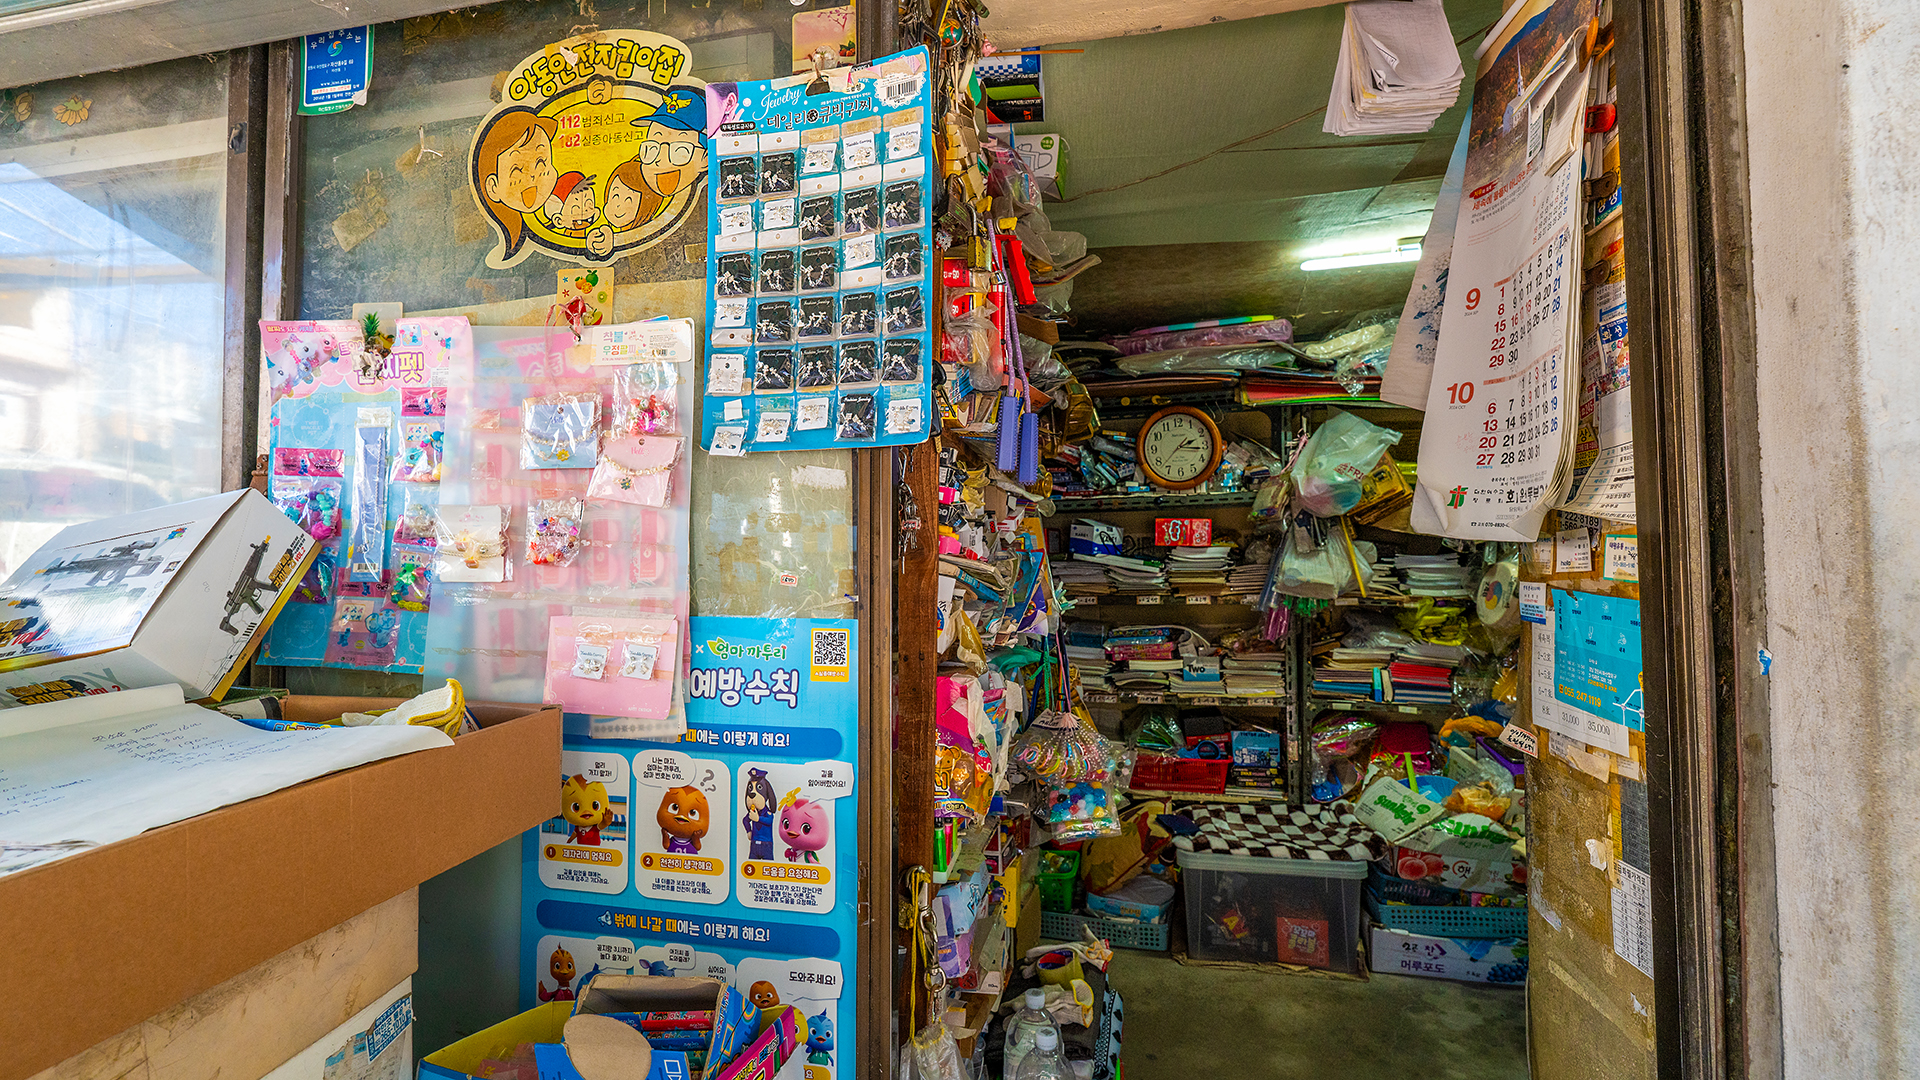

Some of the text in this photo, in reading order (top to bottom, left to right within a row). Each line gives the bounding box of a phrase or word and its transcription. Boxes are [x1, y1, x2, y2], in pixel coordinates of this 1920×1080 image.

[752, 89, 801, 121] Jewelry
[559, 113, 626, 129] 112 범죄신고
[766, 97, 872, 130] 데일리 큐빅귀찌
[558, 130, 644, 148] 182 실종아동신고
[1500, 244, 1553, 298] 1 6
[1497, 254, 1563, 315] 8 13 14
[1465, 287, 1481, 311] 9
[1494, 275, 1561, 333] 15 16 20 21
[1491, 336, 1506, 351] 22
[1509, 331, 1518, 346] 23
[1542, 304, 1550, 320] 27
[1552, 296, 1560, 313] 28
[1489, 348, 1518, 368] 29 30
[1551, 354, 1556, 370] 5
[1446, 382, 1474, 404] 10
[1487, 375, 1557, 415] 6 7 8 12
[1483, 396, 1558, 432] 13 14 15 17 18 19
[1162, 422, 1169, 432] 11
[1173, 417, 1183, 428] 12
[1189, 419, 1193, 429] 1
[1153, 431, 1163, 441] 10
[1197, 428, 1204, 437] 2
[1479, 416, 1558, 449] 20 21 22 25 26
[1150, 444, 1157, 454] 9
[1201, 441, 1208, 450] 3
[1155, 457, 1162, 466] 8
[1199, 454, 1205, 463] 4
[1476, 449, 1525, 466] 27 28 29
[1165, 465, 1171, 475] 7
[1177, 467, 1184, 477] 6
[1190, 463, 1197, 473] 5
[716, 642, 787, 661] 엄마 까투리
[1187, 664, 1205, 673] Two
[690, 667, 799, 709] 예방수칙
[686, 729, 790, 747] 때에는 이렇게 해요!
[651, 757, 663, 765] 나는
[562, 848, 590, 860] 제자리에
[660, 857, 682, 868] 천천히
[683, 860, 713, 871] 생각해요
[762, 866, 786, 878] 도움을
[787, 868, 819, 880] 요청해요
[614, 913, 770, 942] 밖에 나갈 때에는 이렇게 해요!
[1400, 960, 1446, 974] 머루포도
[788, 971, 836, 986] 도와주세요!
